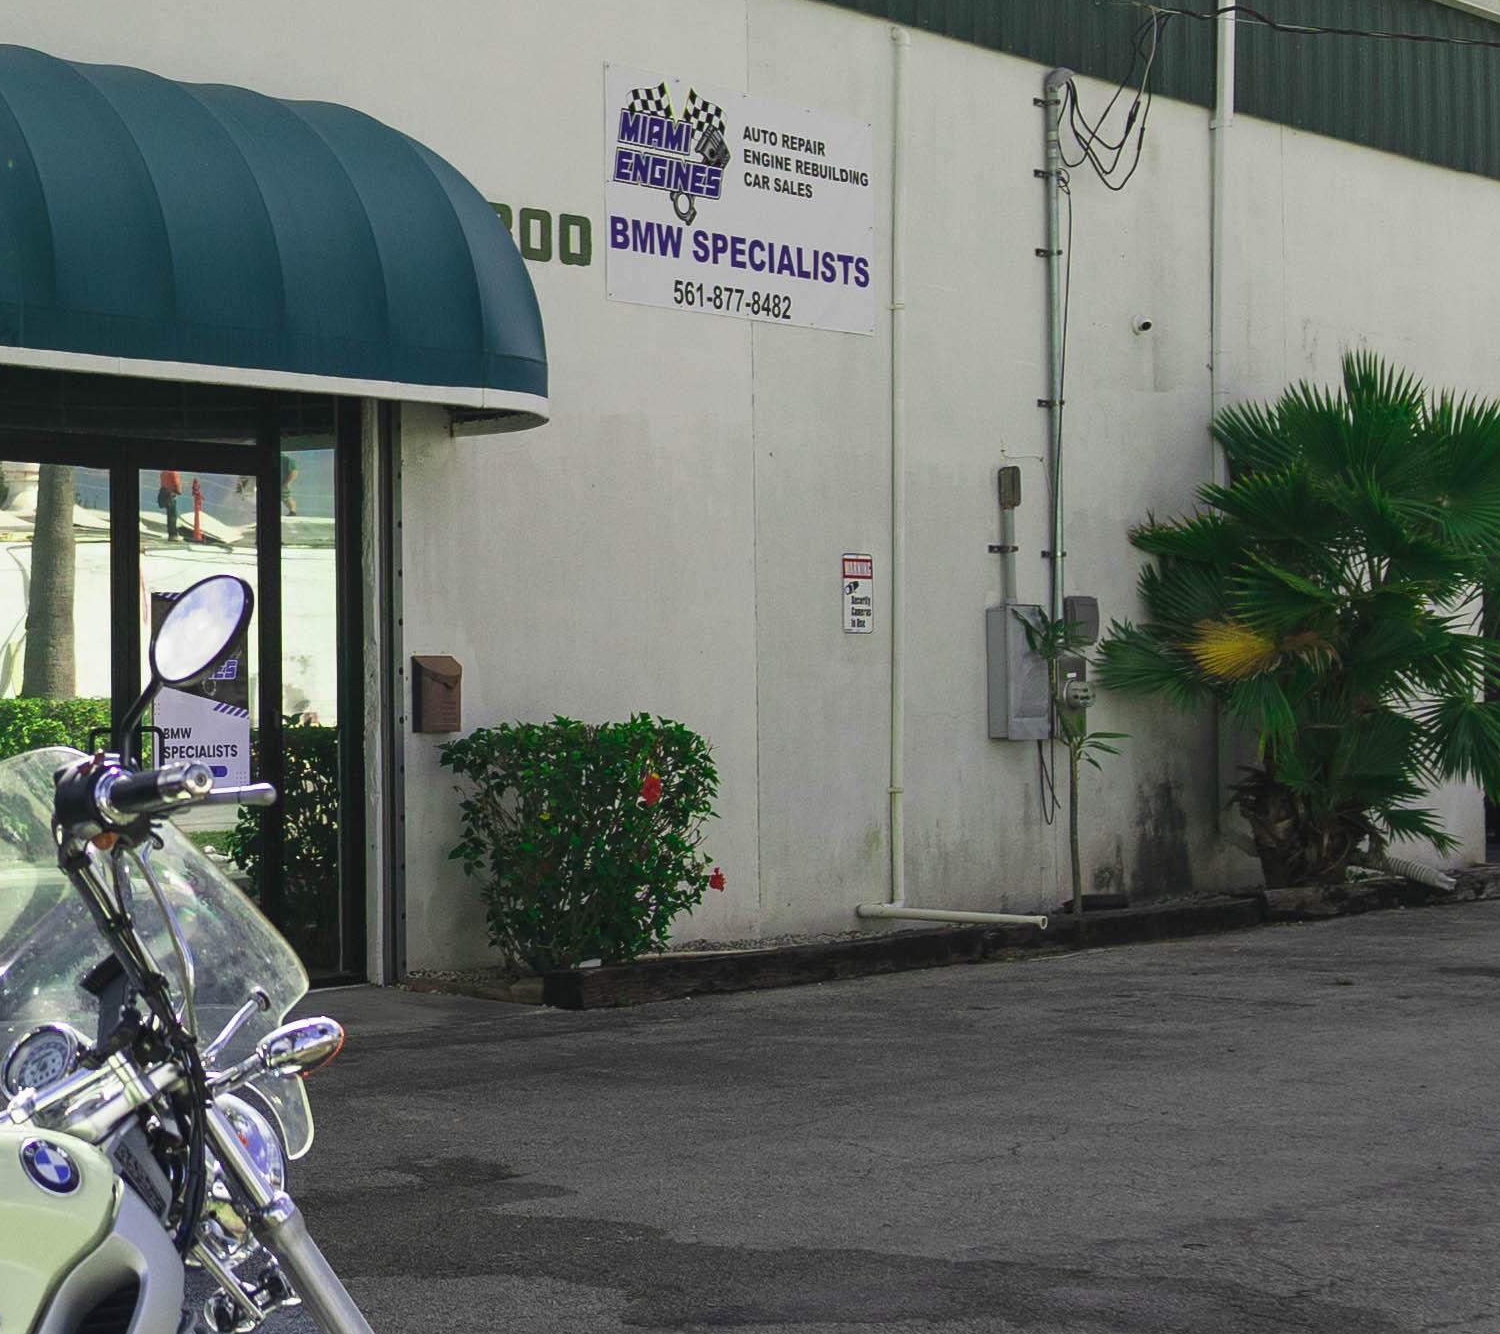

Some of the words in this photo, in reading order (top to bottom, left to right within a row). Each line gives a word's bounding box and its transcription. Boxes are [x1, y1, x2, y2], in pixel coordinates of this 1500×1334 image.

[618, 109, 693, 155] MIAMI
[743, 126, 778, 146] AUTO
[782, 134, 825, 156] REPAIR
[613, 147, 724, 200] ENGINES
[743, 149, 792, 171] ENGINE
[796, 160, 869, 186] REBUILDING
[744, 172, 770, 190] CAR
[774, 178, 813, 198] SALES
[488, 202, 592, 266] 00
[610, 215, 683, 259] BMW
[692, 230, 870, 288] SPECIALISTS
[673, 279, 792, 319] 561-877-8482
[163, 727, 192, 740] BMW
[164, 744, 239, 759] SPECIALISTS
